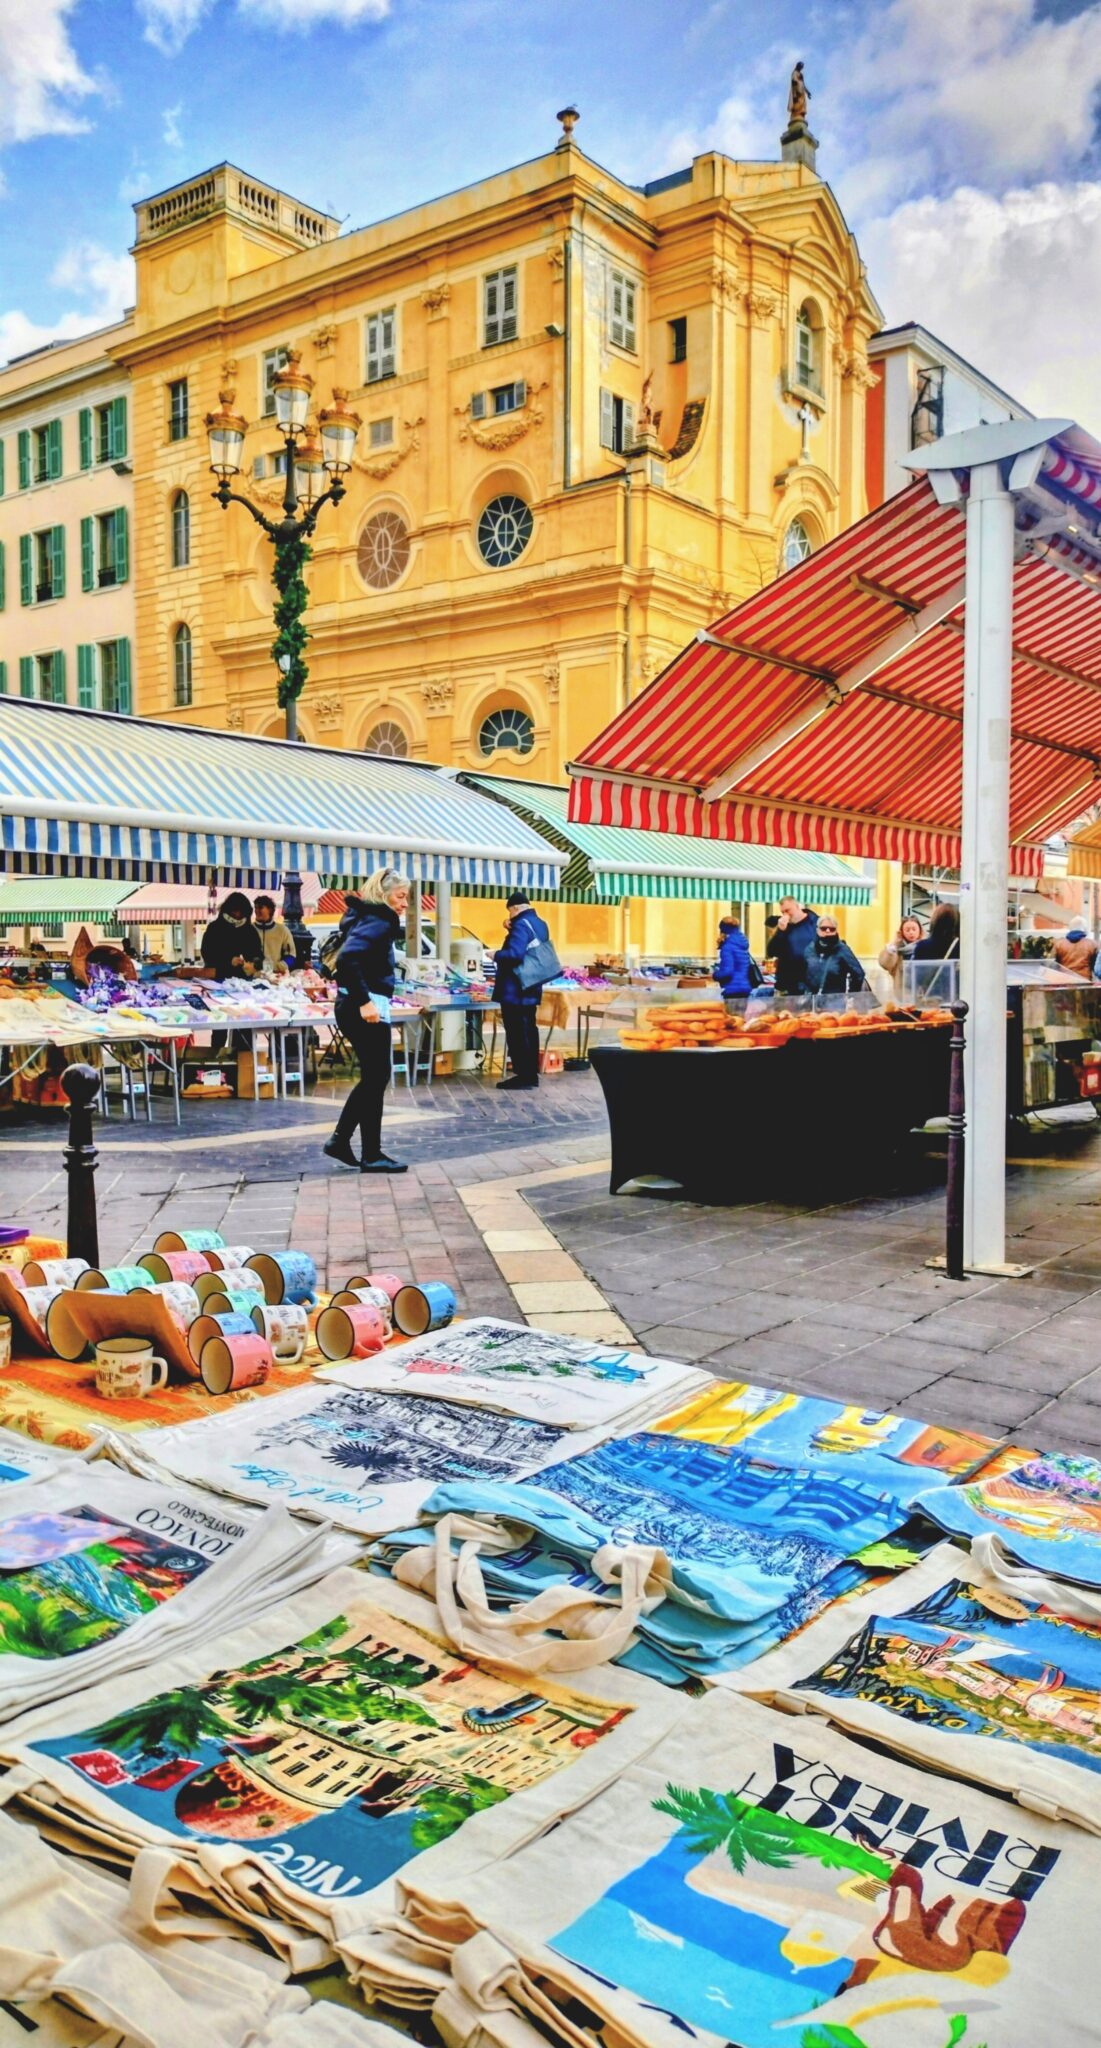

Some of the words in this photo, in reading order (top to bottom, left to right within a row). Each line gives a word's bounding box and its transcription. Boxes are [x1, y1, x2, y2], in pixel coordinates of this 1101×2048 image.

[256, 1842, 362, 1896] Nice
[734, 1771, 1046, 1902] FRENCH
[773, 1742, 1061, 1876] RIVIERA
